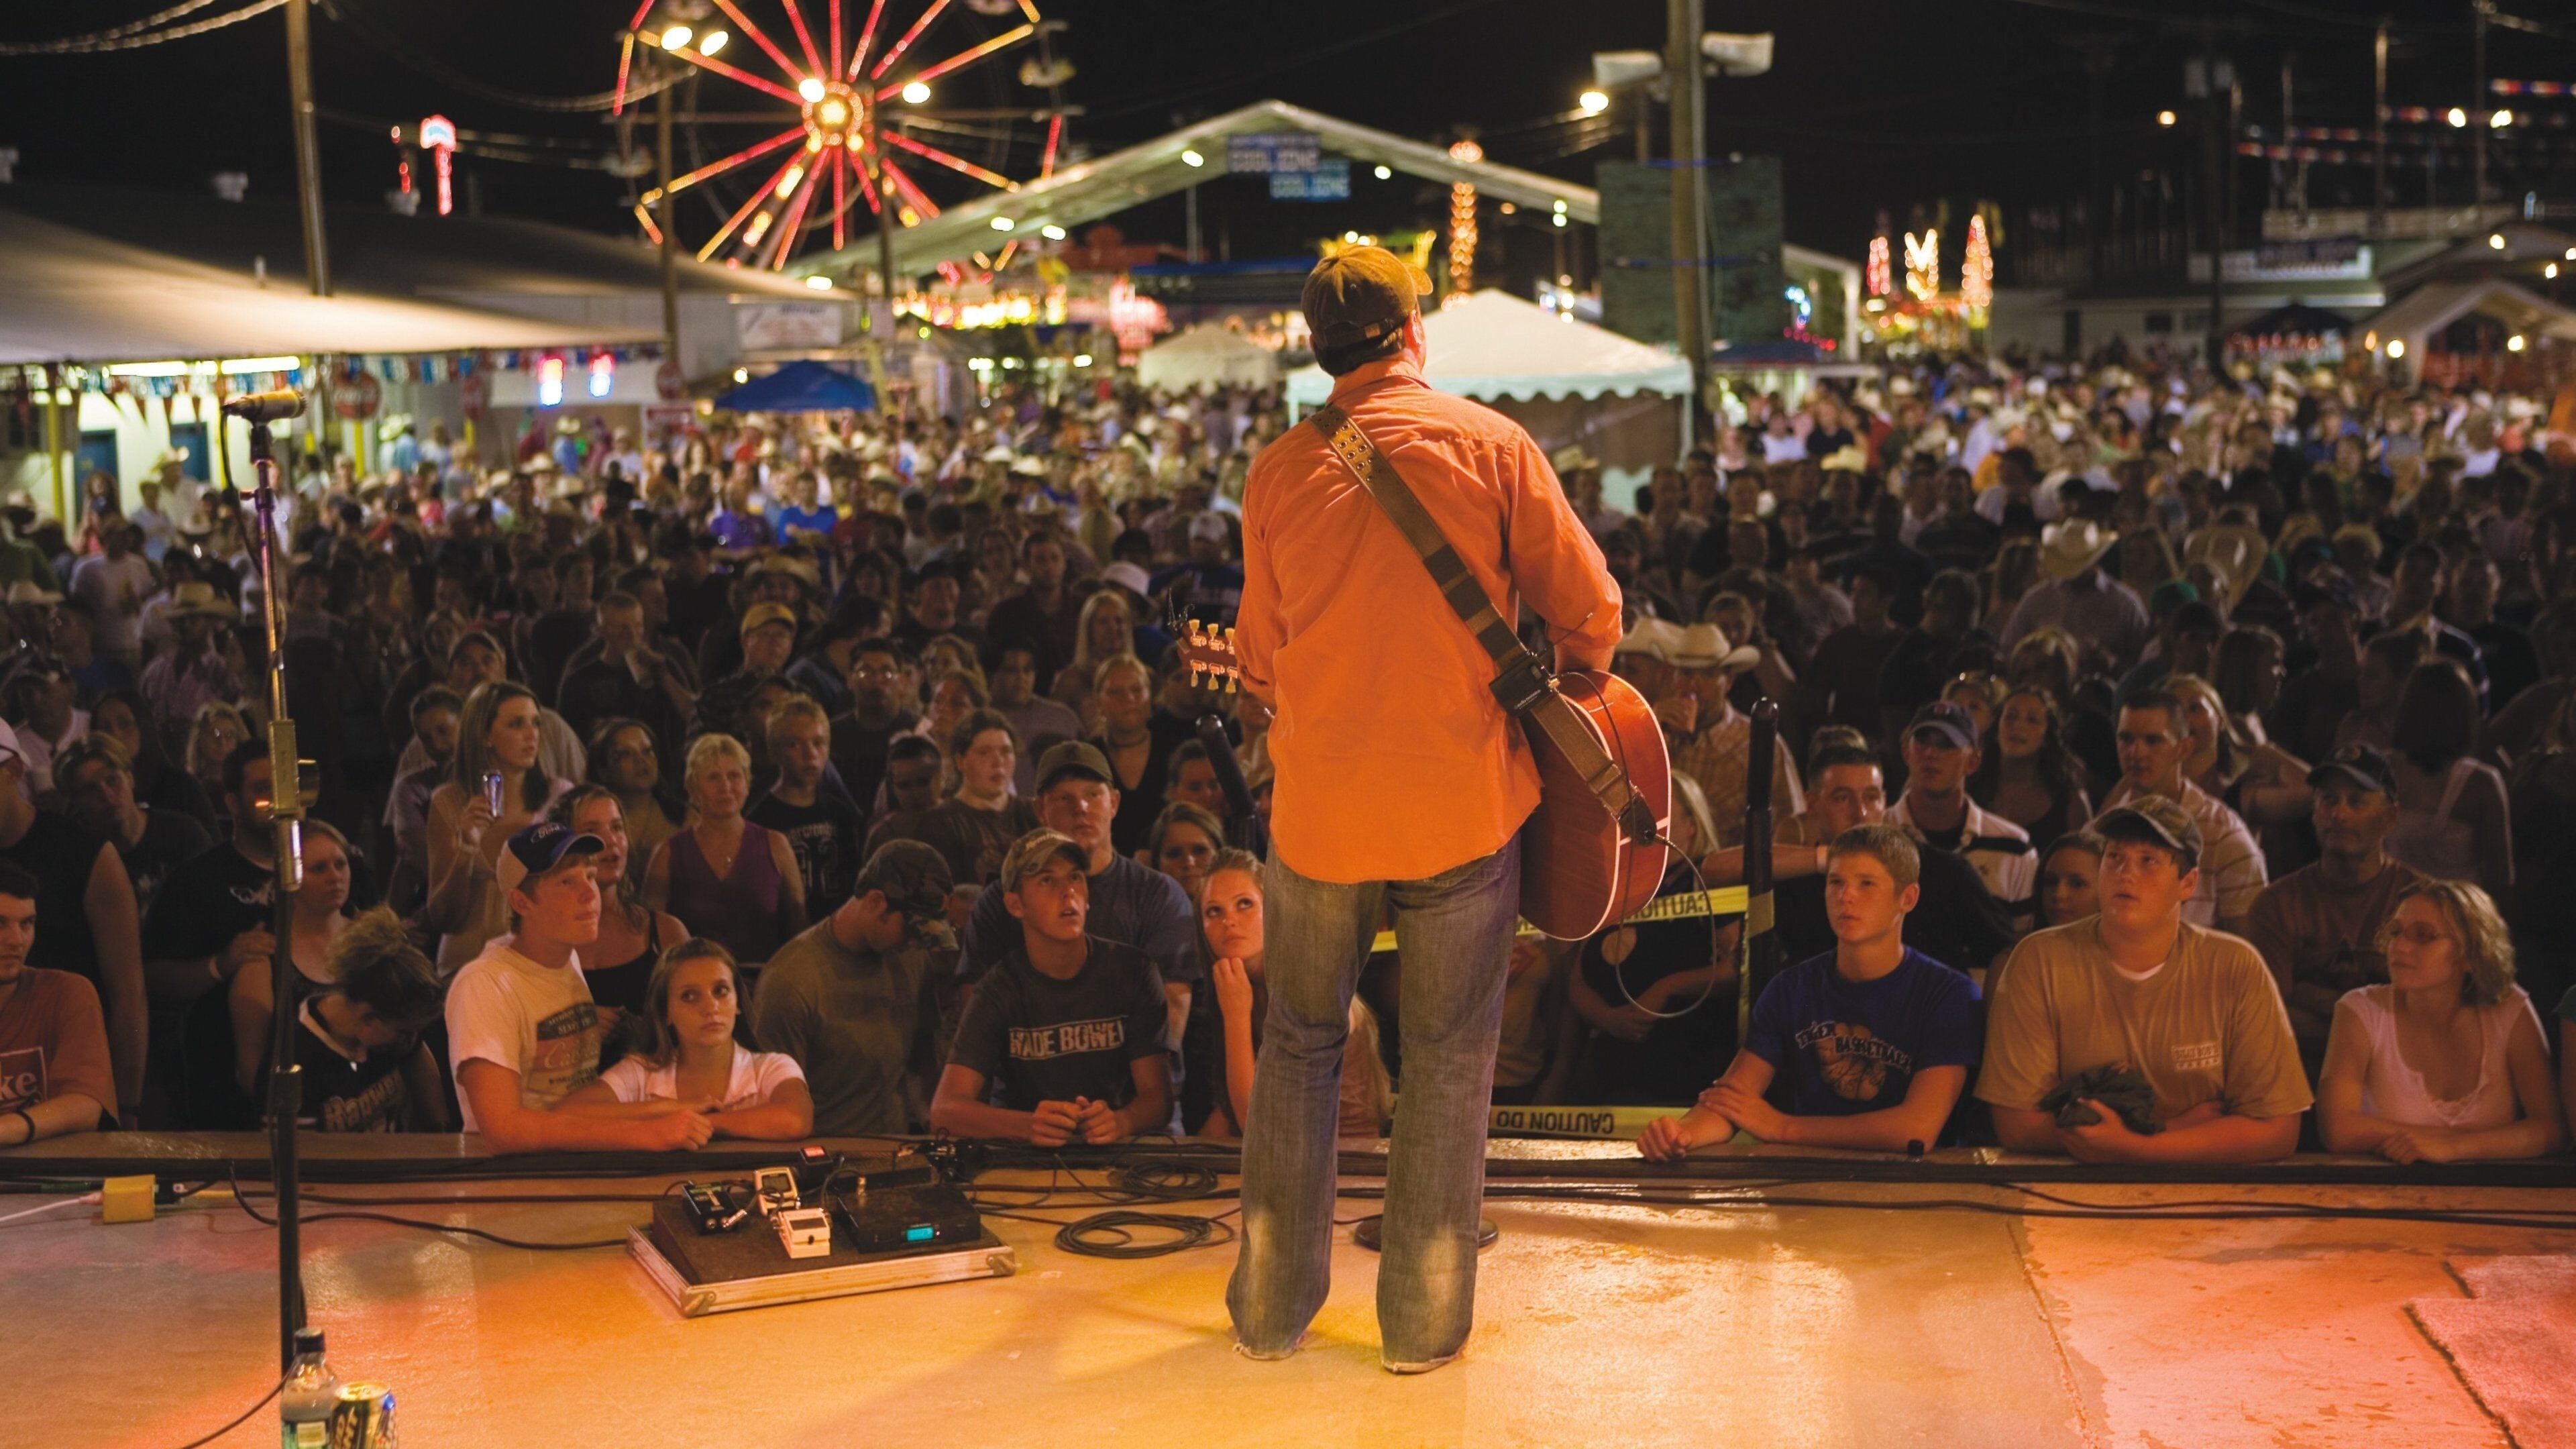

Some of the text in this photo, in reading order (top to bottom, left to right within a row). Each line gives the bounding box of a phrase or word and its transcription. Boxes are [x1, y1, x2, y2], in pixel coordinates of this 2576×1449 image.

[1059, 1018, 1124, 1053] BOWE
[1497, 1110, 1614, 1134] CAUTION DO
